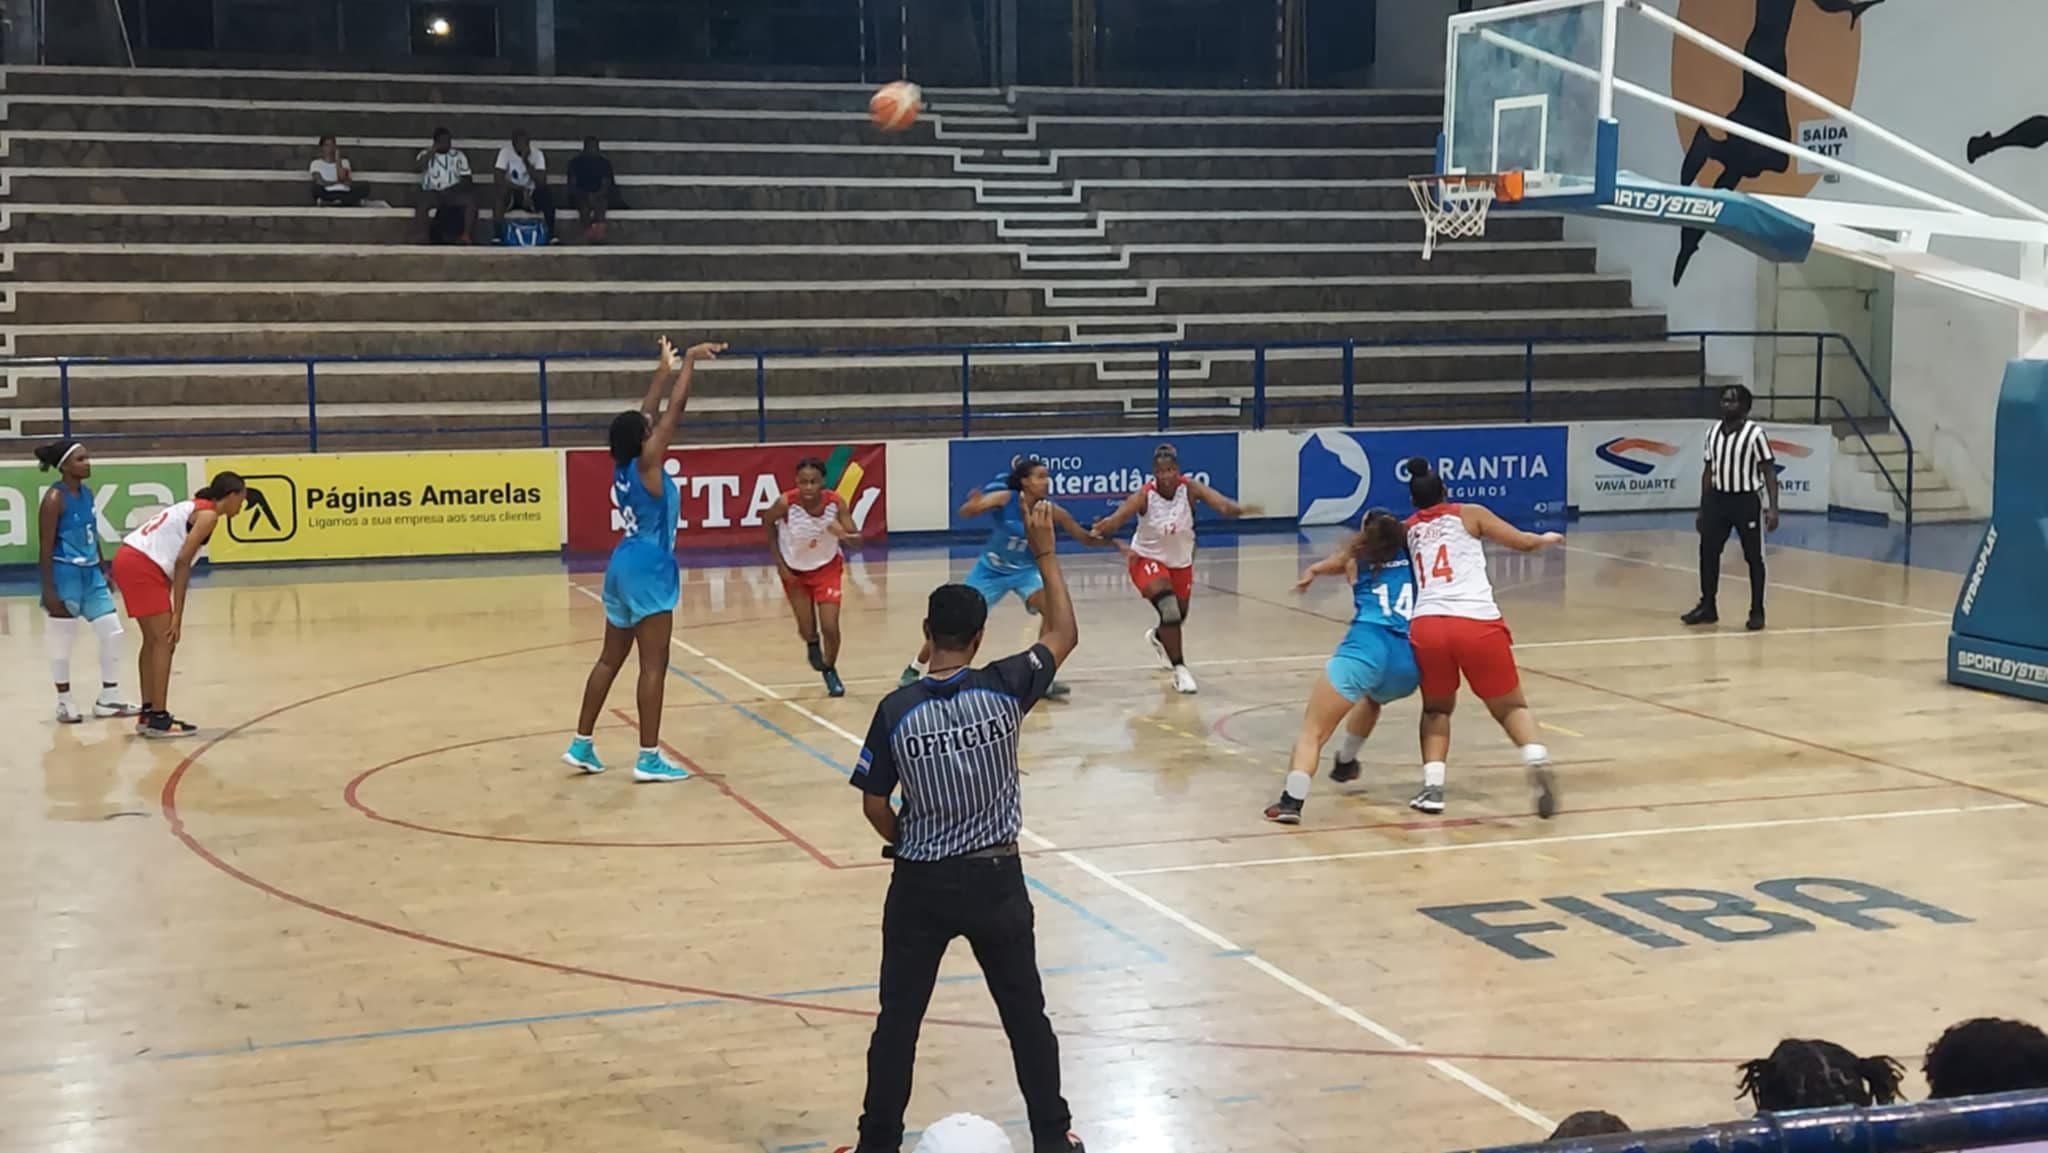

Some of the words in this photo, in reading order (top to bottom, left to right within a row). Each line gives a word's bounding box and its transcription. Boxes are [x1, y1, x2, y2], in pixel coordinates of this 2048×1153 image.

[1803, 125, 1848, 141] SAÍDA
[1395, 454, 1549, 483] GRANTIA
[1629, 478, 1678, 491] DUARTE
[306, 486, 413, 514] Páginas
[420, 482, 541, 507] Amarelas
[1447, 485, 1507, 498] EGUROS
[308, 517, 358, 530] Ligamos
[361, 518, 369, 527] a
[371, 516, 391, 526] sua
[394, 513, 444, 527] empresa
[446, 513, 467, 524] aos
[470, 511, 497, 523] seus
[498, 509, 542, 522] clientes
[1415, 543, 1454, 589] 14
[1372, 582, 1413, 622] 14
[1957, 650, 2048, 682] SPORTSYSTE
[904, 713, 1017, 760] OFFICIAL
[1416, 876, 1976, 961] FIBA
